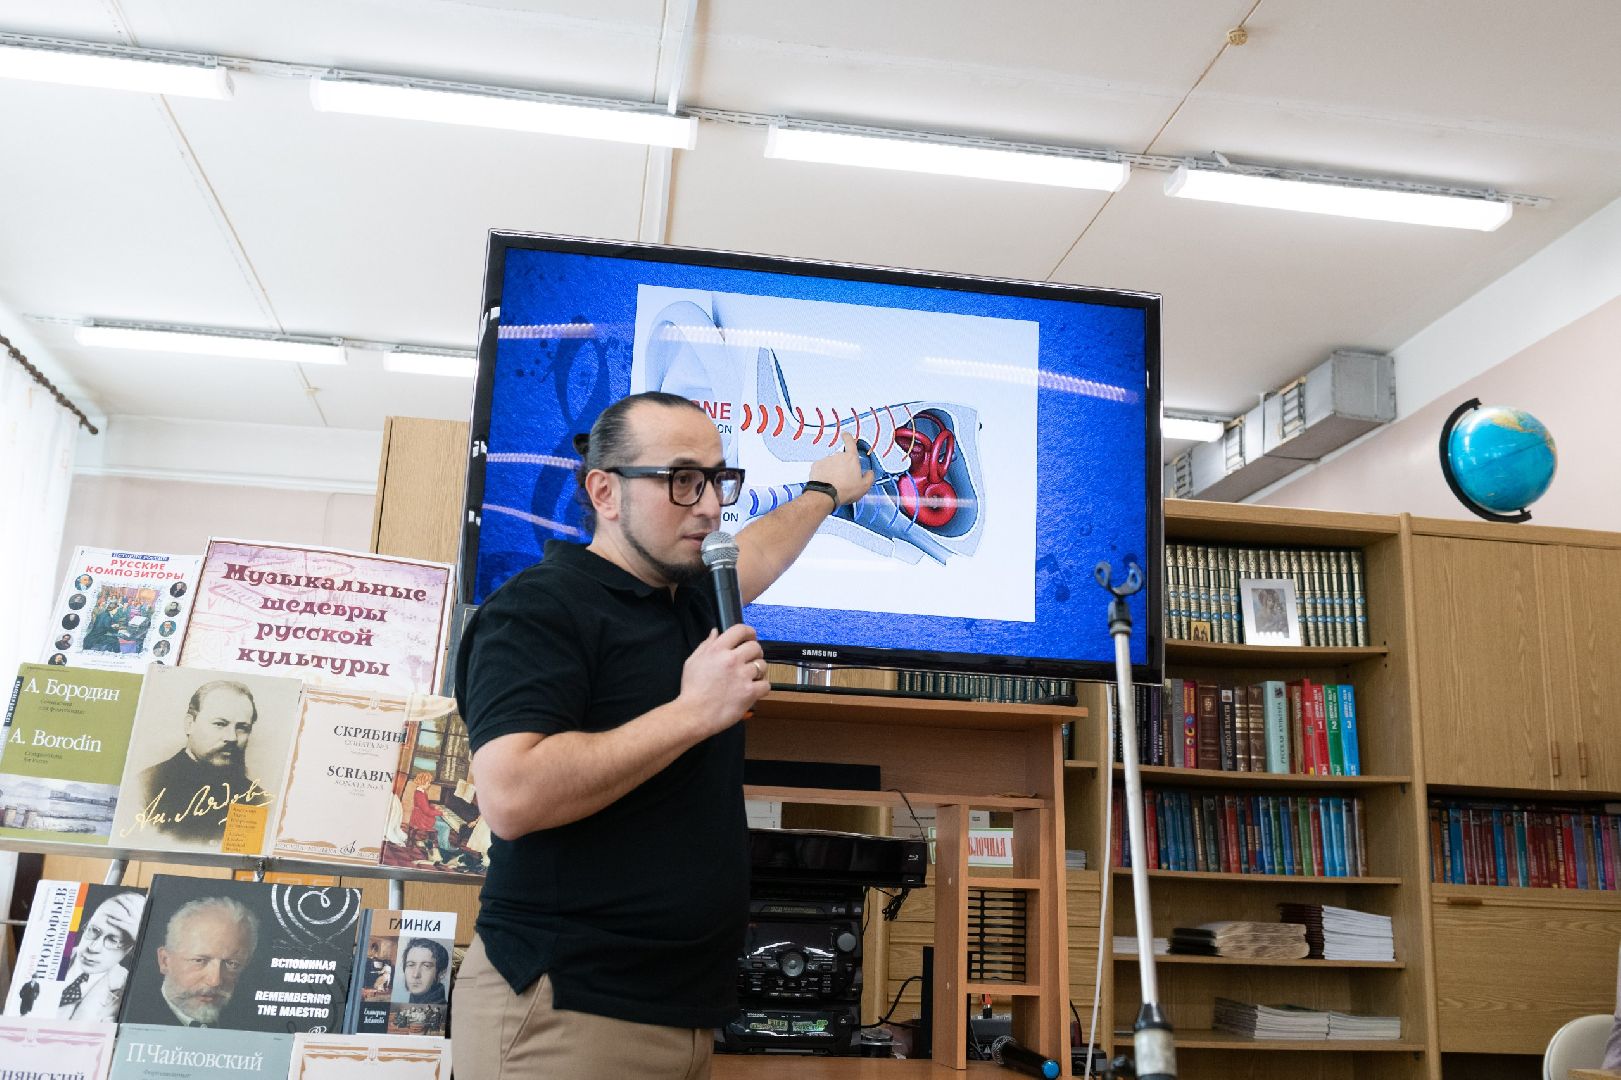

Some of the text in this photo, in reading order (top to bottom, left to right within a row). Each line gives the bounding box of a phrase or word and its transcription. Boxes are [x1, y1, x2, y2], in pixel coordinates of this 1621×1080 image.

[692, 400, 731, 420] NE
[86, 566, 184, 579] КОМПОЗИТОРЫ
[111, 559, 165, 571] РУССКИЕ
[221, 562, 427, 602] Музыкальные
[259, 597, 388, 622] шедевры
[255, 622, 375, 646] русской
[236, 648, 390, 677] культуры
[802, 649, 838, 658] SAMSUNG
[45, 679, 120, 702] Бородин
[32, 730, 101, 752] Borodin
[333, 725, 403, 743] СКРЯБИН
[327, 765, 395, 783] SCRIABIN
[36, 887, 67, 978] ПРОКОФЬЕВ
[389, 919, 441, 932] ГЛИНКА
[271, 958, 337, 971] ВСПОМИНАЯ
[284, 973, 334, 985] МАЭСТРО
[255, 991, 331, 1005] REMEMBERING
[258, 1005, 329, 1018] THE MAESTRO
